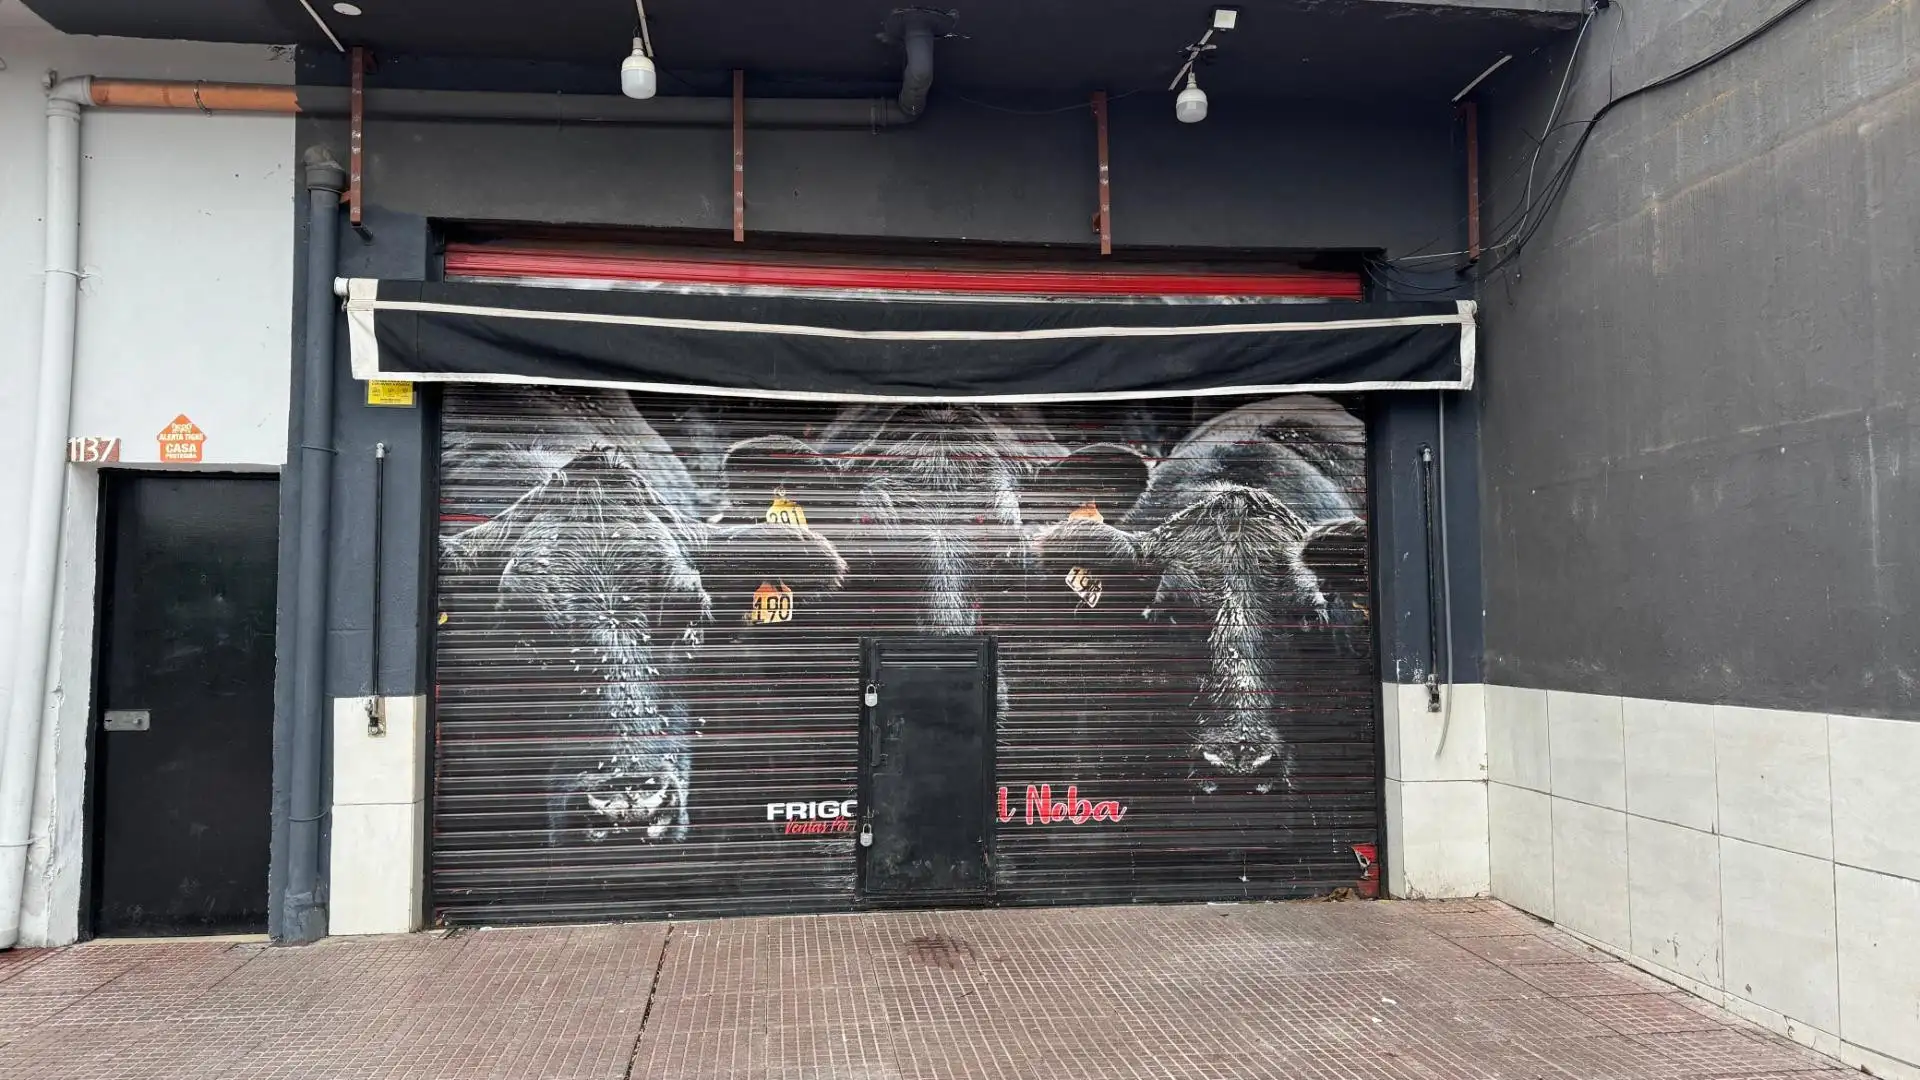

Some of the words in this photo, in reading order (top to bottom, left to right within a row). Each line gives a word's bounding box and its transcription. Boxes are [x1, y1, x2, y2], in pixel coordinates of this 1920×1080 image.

[68, 437, 116, 463] 1137
[159, 433, 184, 441] ALERTA
[165, 442, 197, 453] CASA
[754, 595, 790, 621] 190
[1025, 783, 1128, 825] Noba
